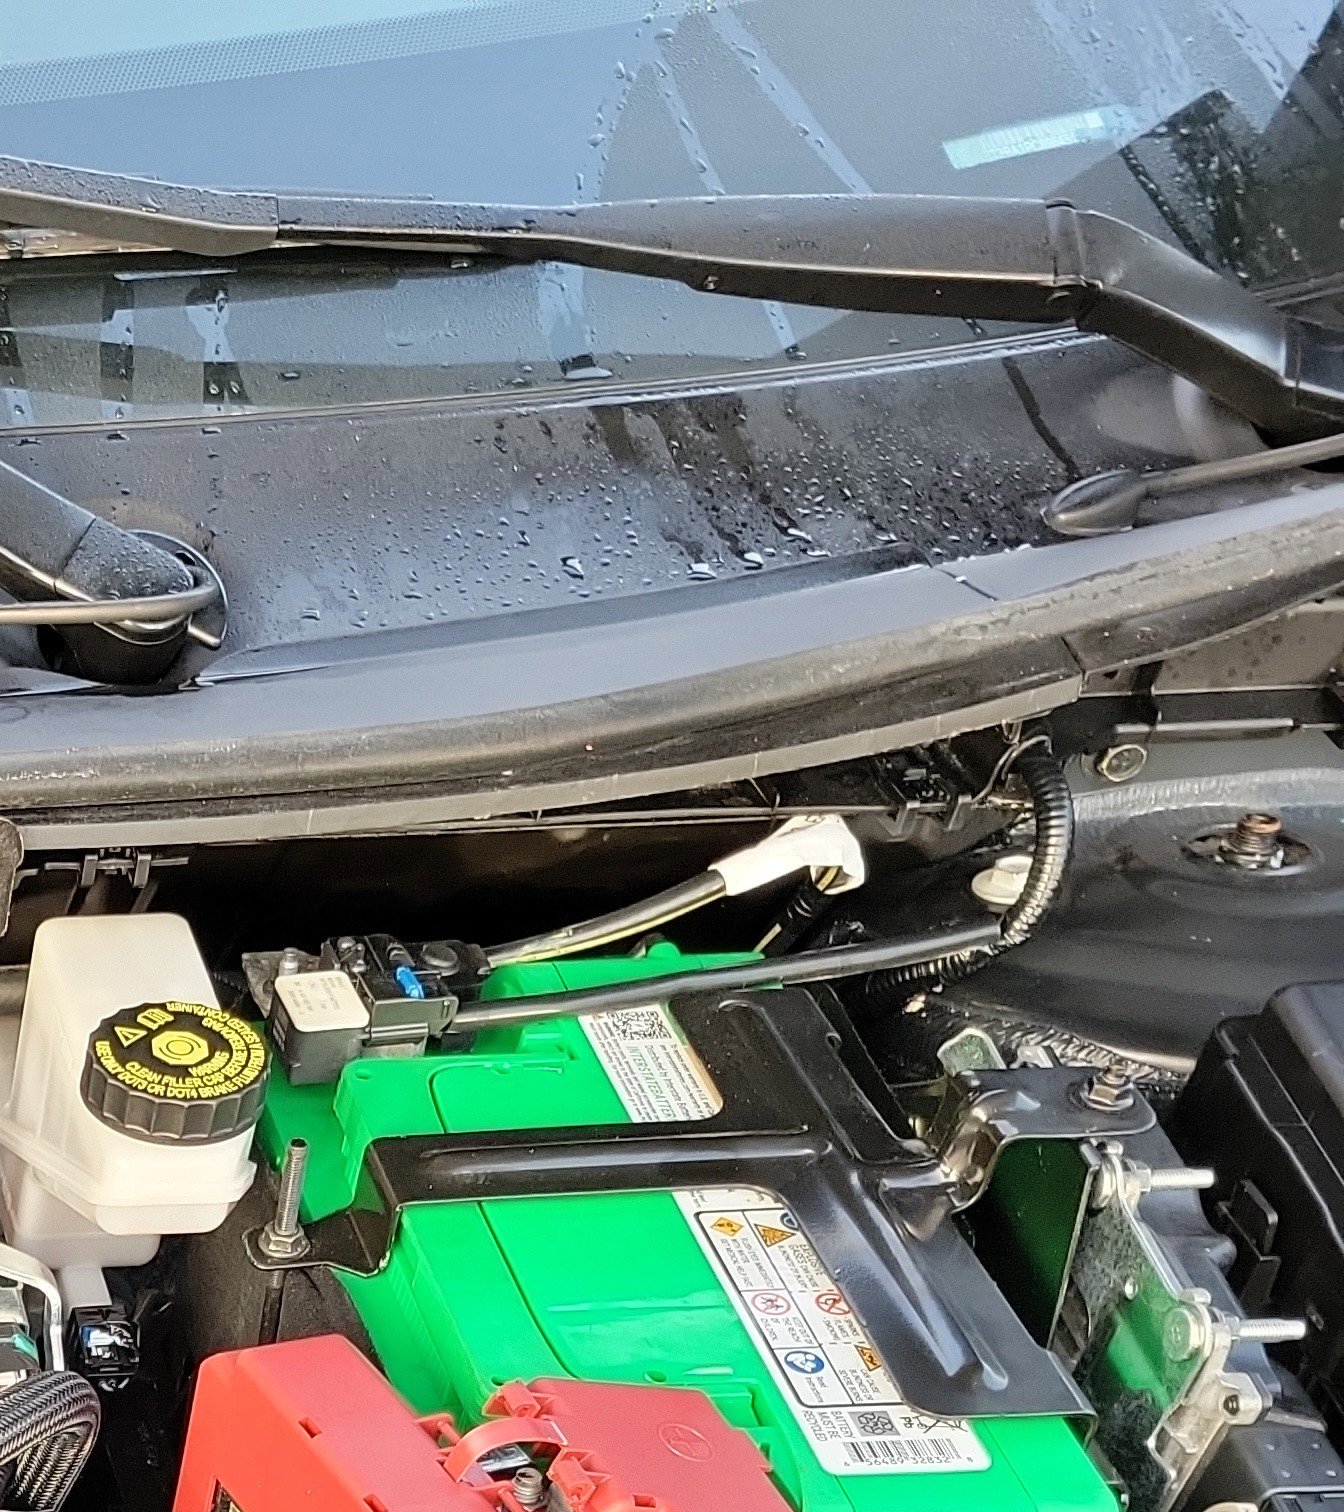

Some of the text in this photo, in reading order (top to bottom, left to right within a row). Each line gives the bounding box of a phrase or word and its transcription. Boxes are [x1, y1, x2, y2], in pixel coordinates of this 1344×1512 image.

[166, 1002, 230, 1022] CONTAINER
[95, 1041, 112, 1057] USE
[117, 1071, 148, 1089] DOT3
[125, 1061, 162, 1083] CLEAN
[161, 1075, 204, 1088] FILLER
[202, 1072, 225, 1085] CAP
[625, 1045, 676, 1119] INTERSTATEBATTER
[147, 1083, 165, 1096] OR
[166, 1087, 198, 1099] DOT4
[198, 1080, 239, 1098] BRAKE
[801, 1409, 827, 1441] RECYCLED
[817, 1411, 839, 1439] MUST BE
[830, 1410, 853, 1438] BATTERY
[900, 1415, 914, 1428] Pb
[865, 1458, 905, 1466] 56489
[911, 1456, 951, 1464] 32832
